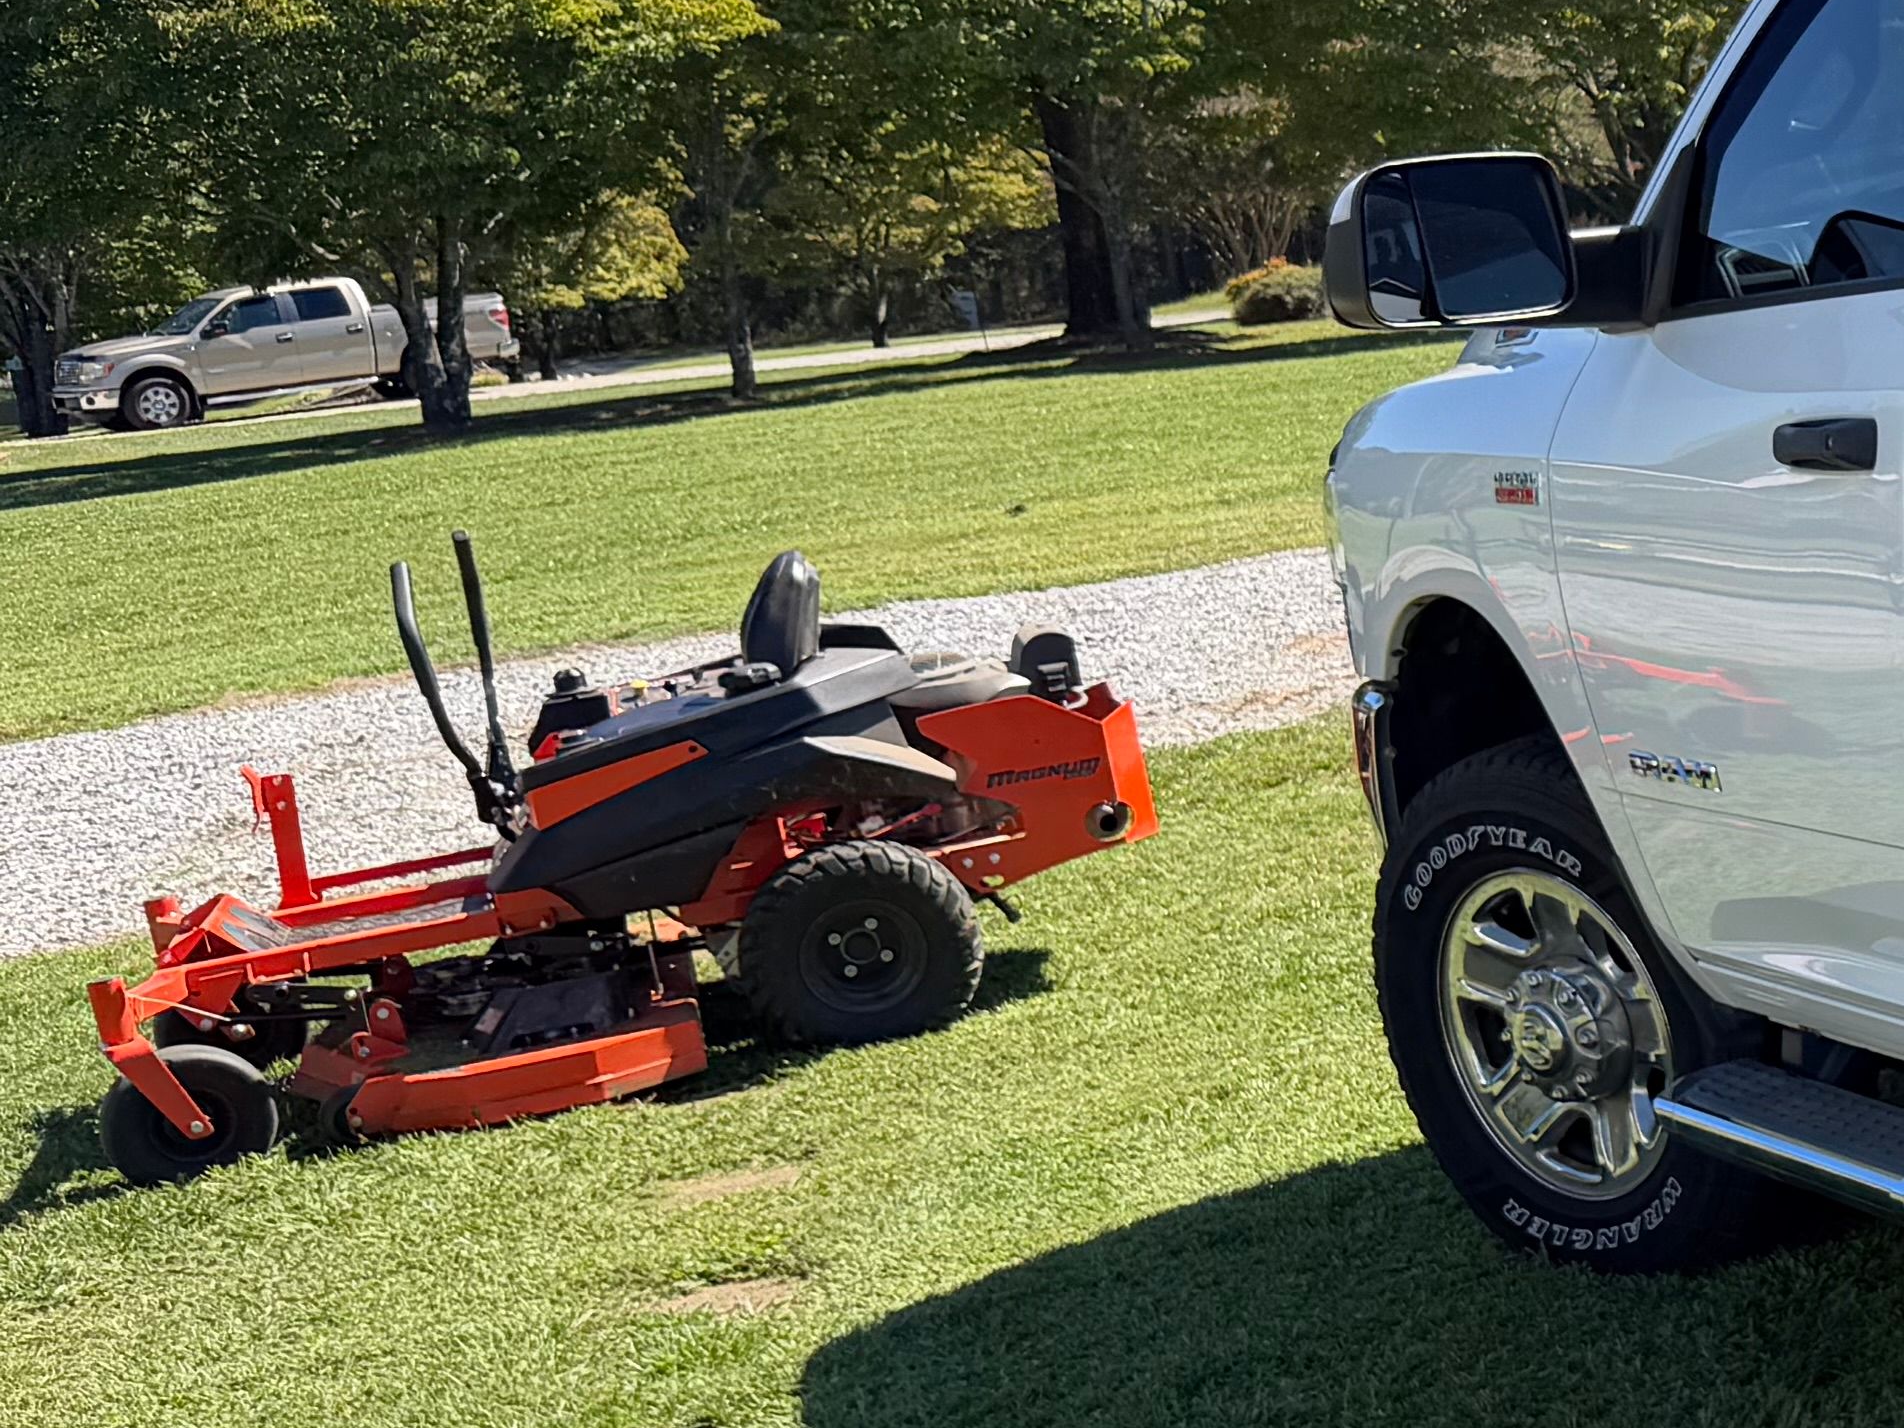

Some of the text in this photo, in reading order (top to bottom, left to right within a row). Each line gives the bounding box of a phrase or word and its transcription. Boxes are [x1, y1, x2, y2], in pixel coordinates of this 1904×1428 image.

[986, 756, 1100, 788] MAGNUM
[1628, 749, 1722, 792] RAM
[1404, 824, 1582, 911] GOODYEAR
[1502, 1176, 1683, 1251] WRANGLER
